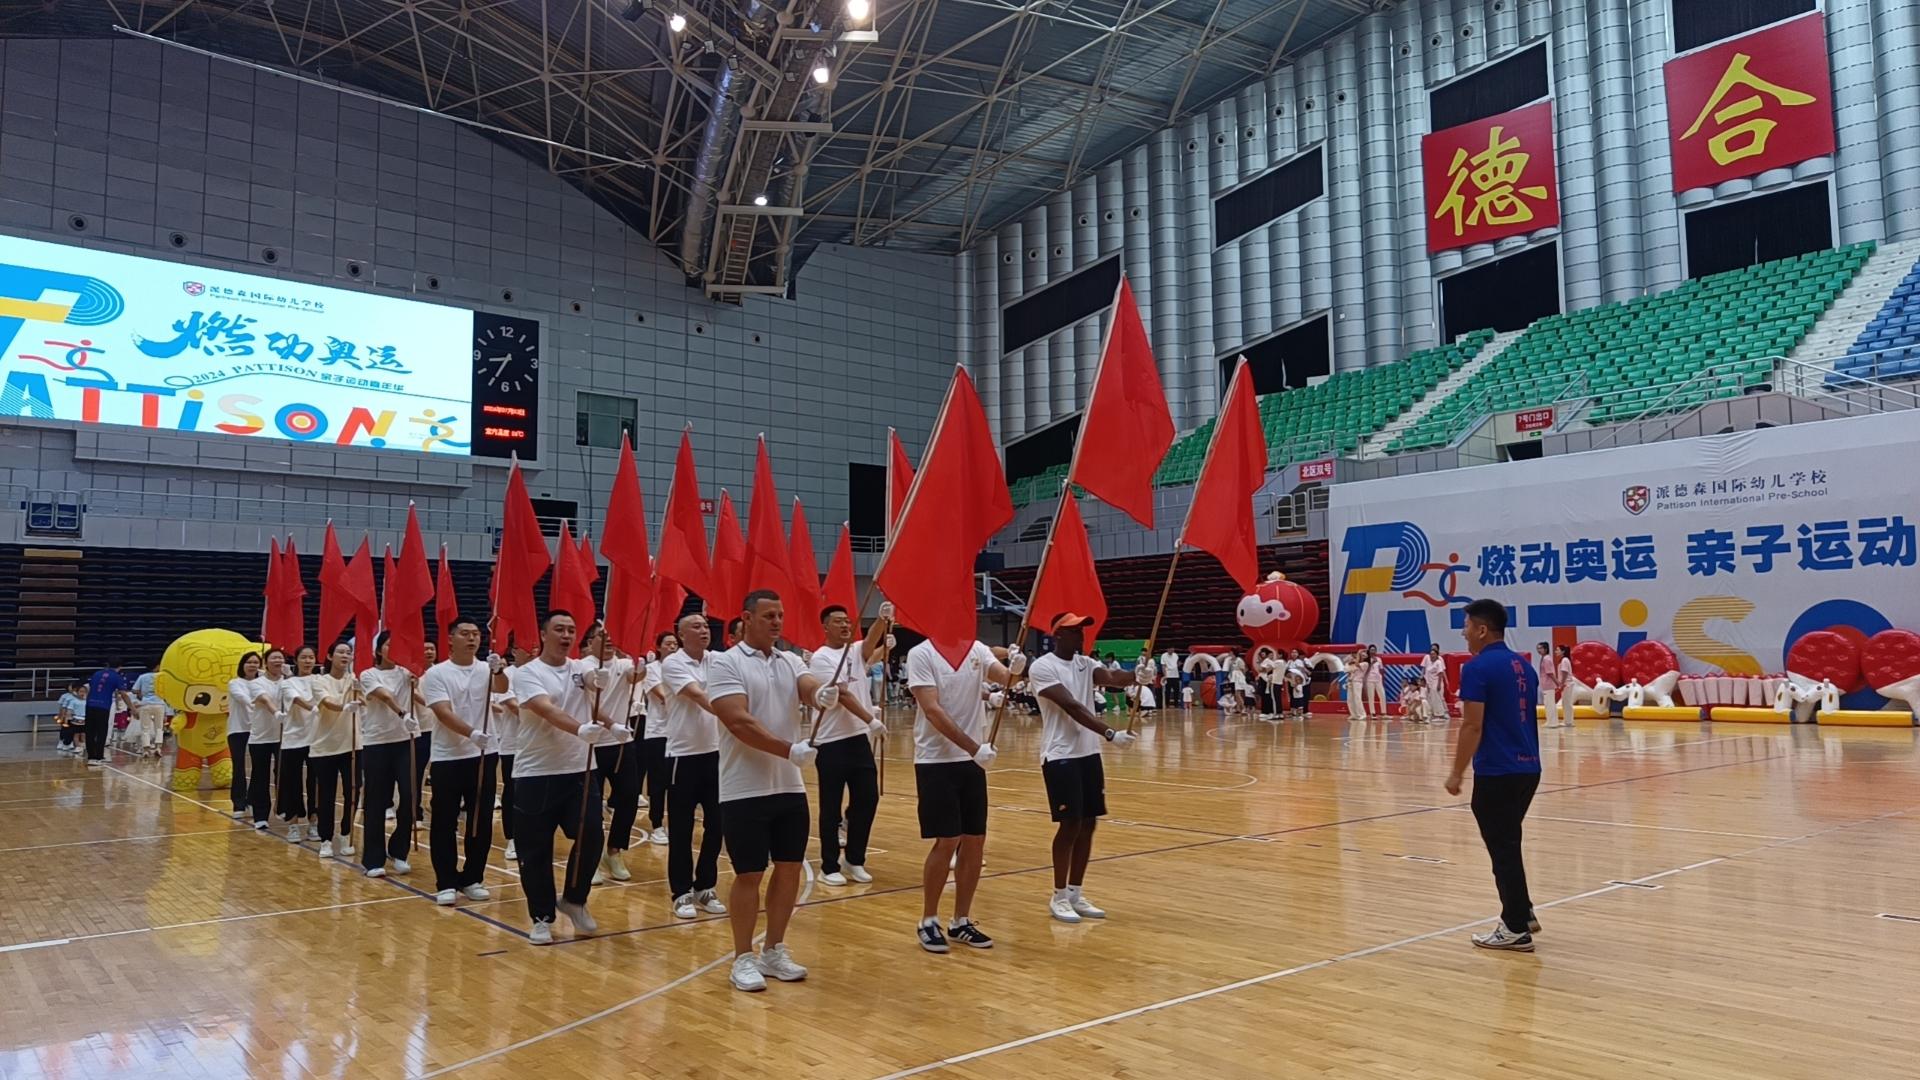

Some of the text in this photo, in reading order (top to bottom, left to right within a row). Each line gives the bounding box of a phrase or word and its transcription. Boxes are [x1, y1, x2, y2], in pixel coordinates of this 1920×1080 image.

[1679, 53, 1817, 166] 合
[1434, 126, 1548, 236] 德
[500, 326, 514, 338] 12
[473, 349, 482, 361] 9
[530, 358, 539, 369] 3
[193, 369, 226, 383] 2024
[232, 363, 318, 378] PATTISON
[500, 381, 510, 392] 6
[1656, 469, 1828, 499] 派德森国际幼儿学校
[1656, 487, 1828, 511] Pattison International Pre-School
[1477, 515, 1918, 587] 燃动奥运 亲子运动
